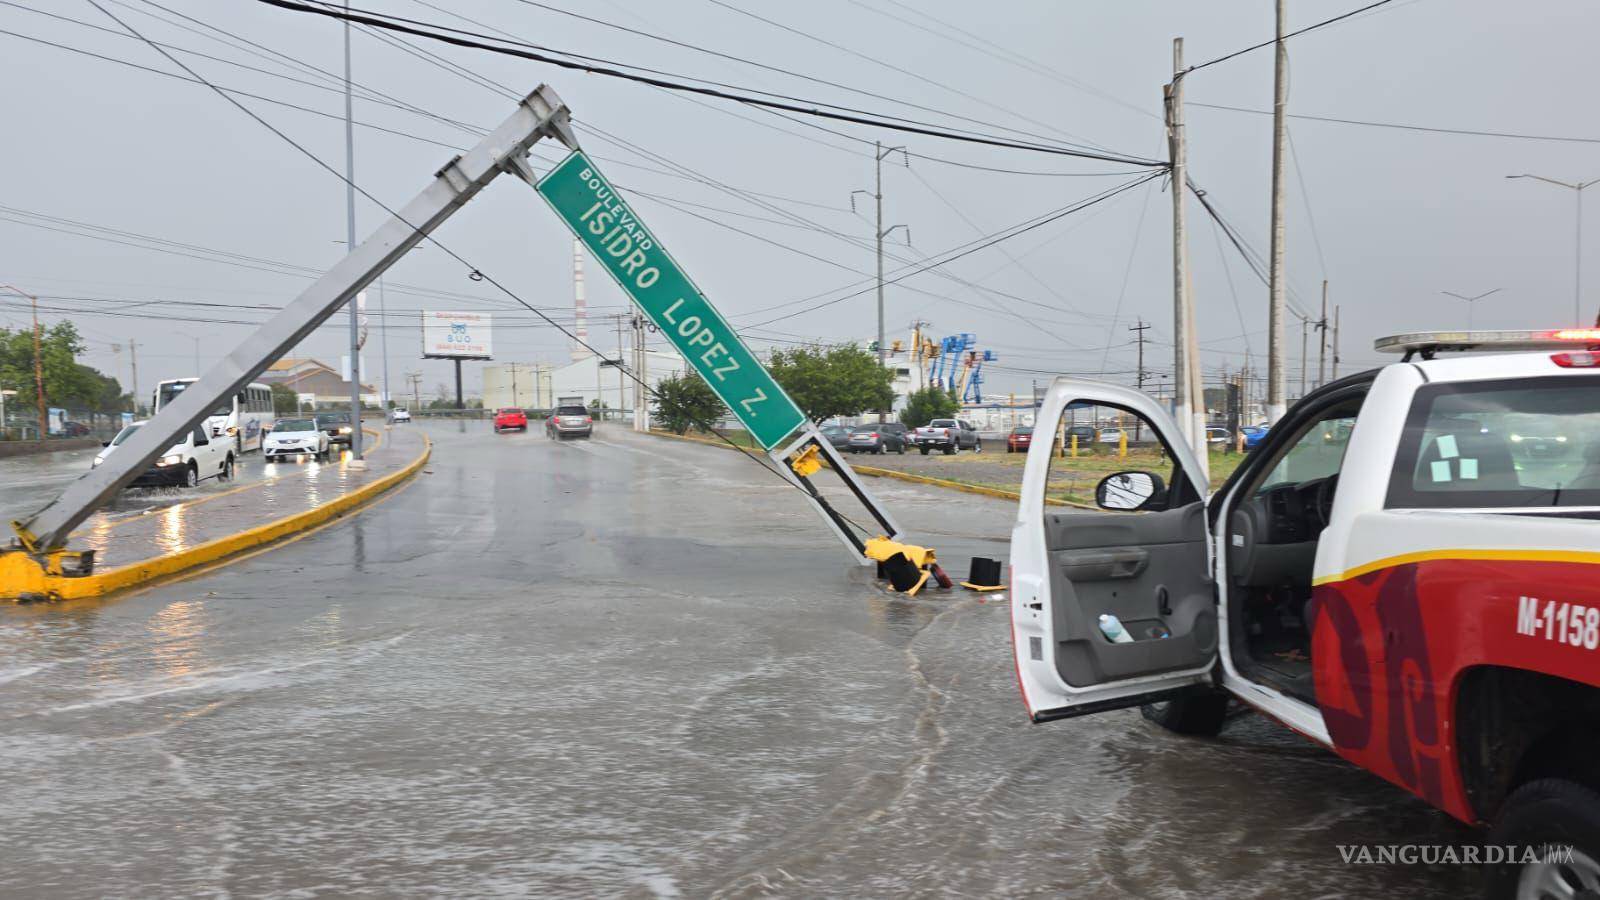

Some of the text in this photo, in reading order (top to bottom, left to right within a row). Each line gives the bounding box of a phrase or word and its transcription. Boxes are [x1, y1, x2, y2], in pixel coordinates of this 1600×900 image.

[579, 168, 653, 251] BOULEVARD
[579, 202, 768, 417] ISIDRO LOPEZ Z.
[1516, 595, 1599, 650] M-1158
